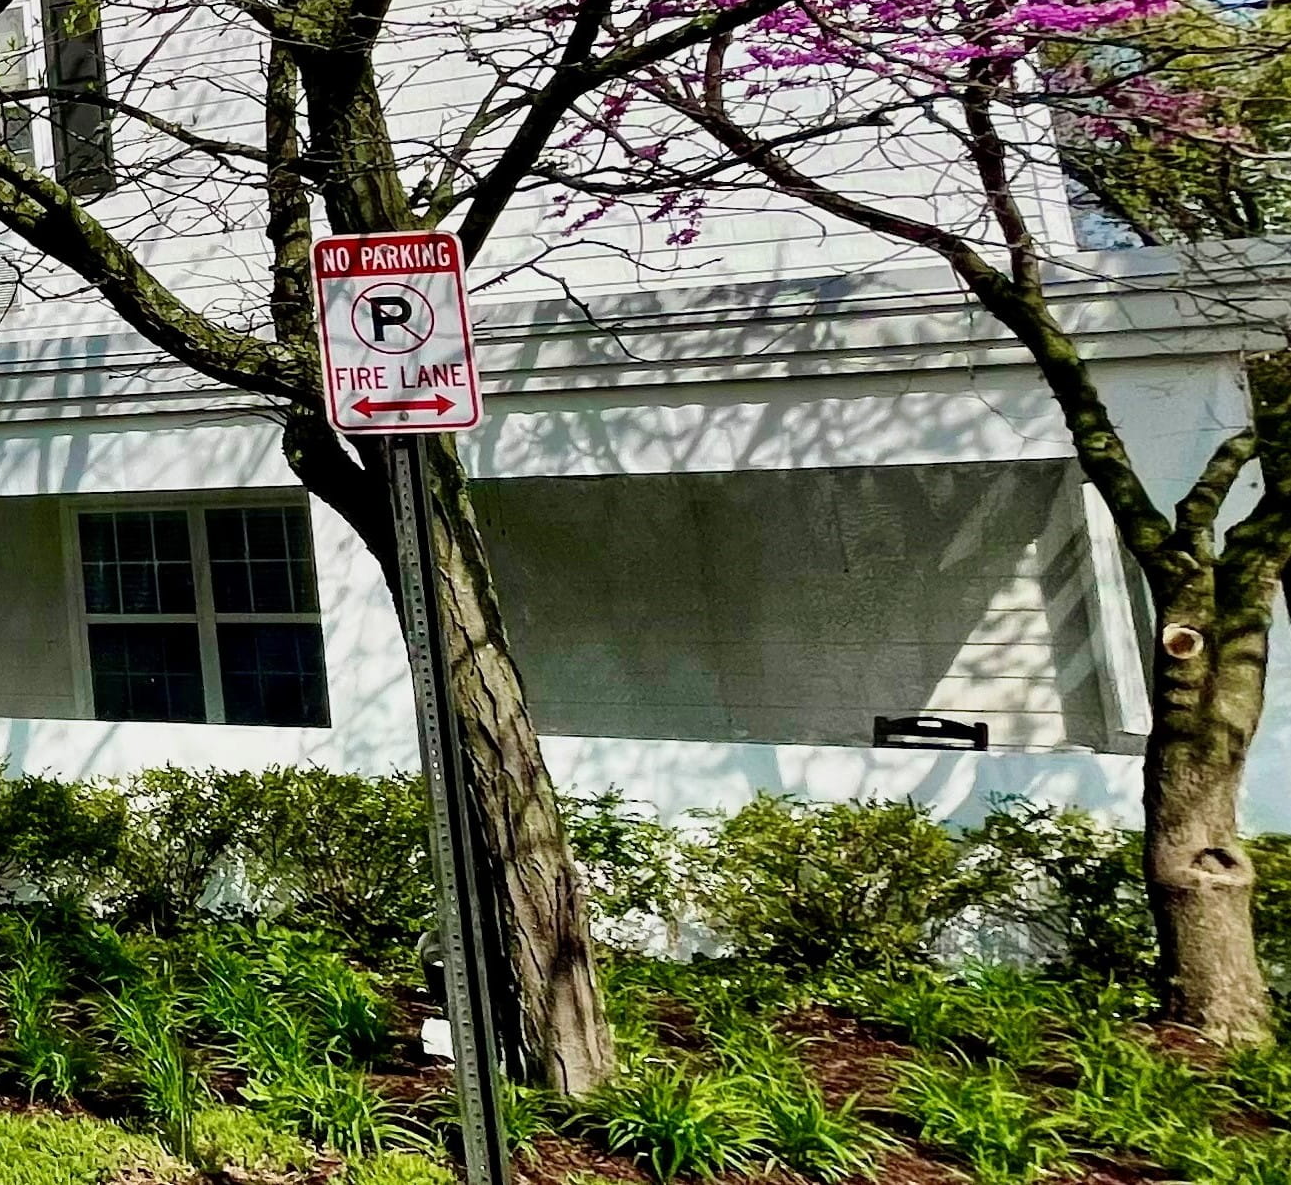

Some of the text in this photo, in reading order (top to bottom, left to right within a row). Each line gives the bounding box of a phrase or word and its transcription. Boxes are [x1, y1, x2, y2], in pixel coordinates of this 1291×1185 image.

[321, 242, 451, 273] NO PARKING
[370, 296, 412, 342] P
[335, 363, 466, 391] FIRE LANE
